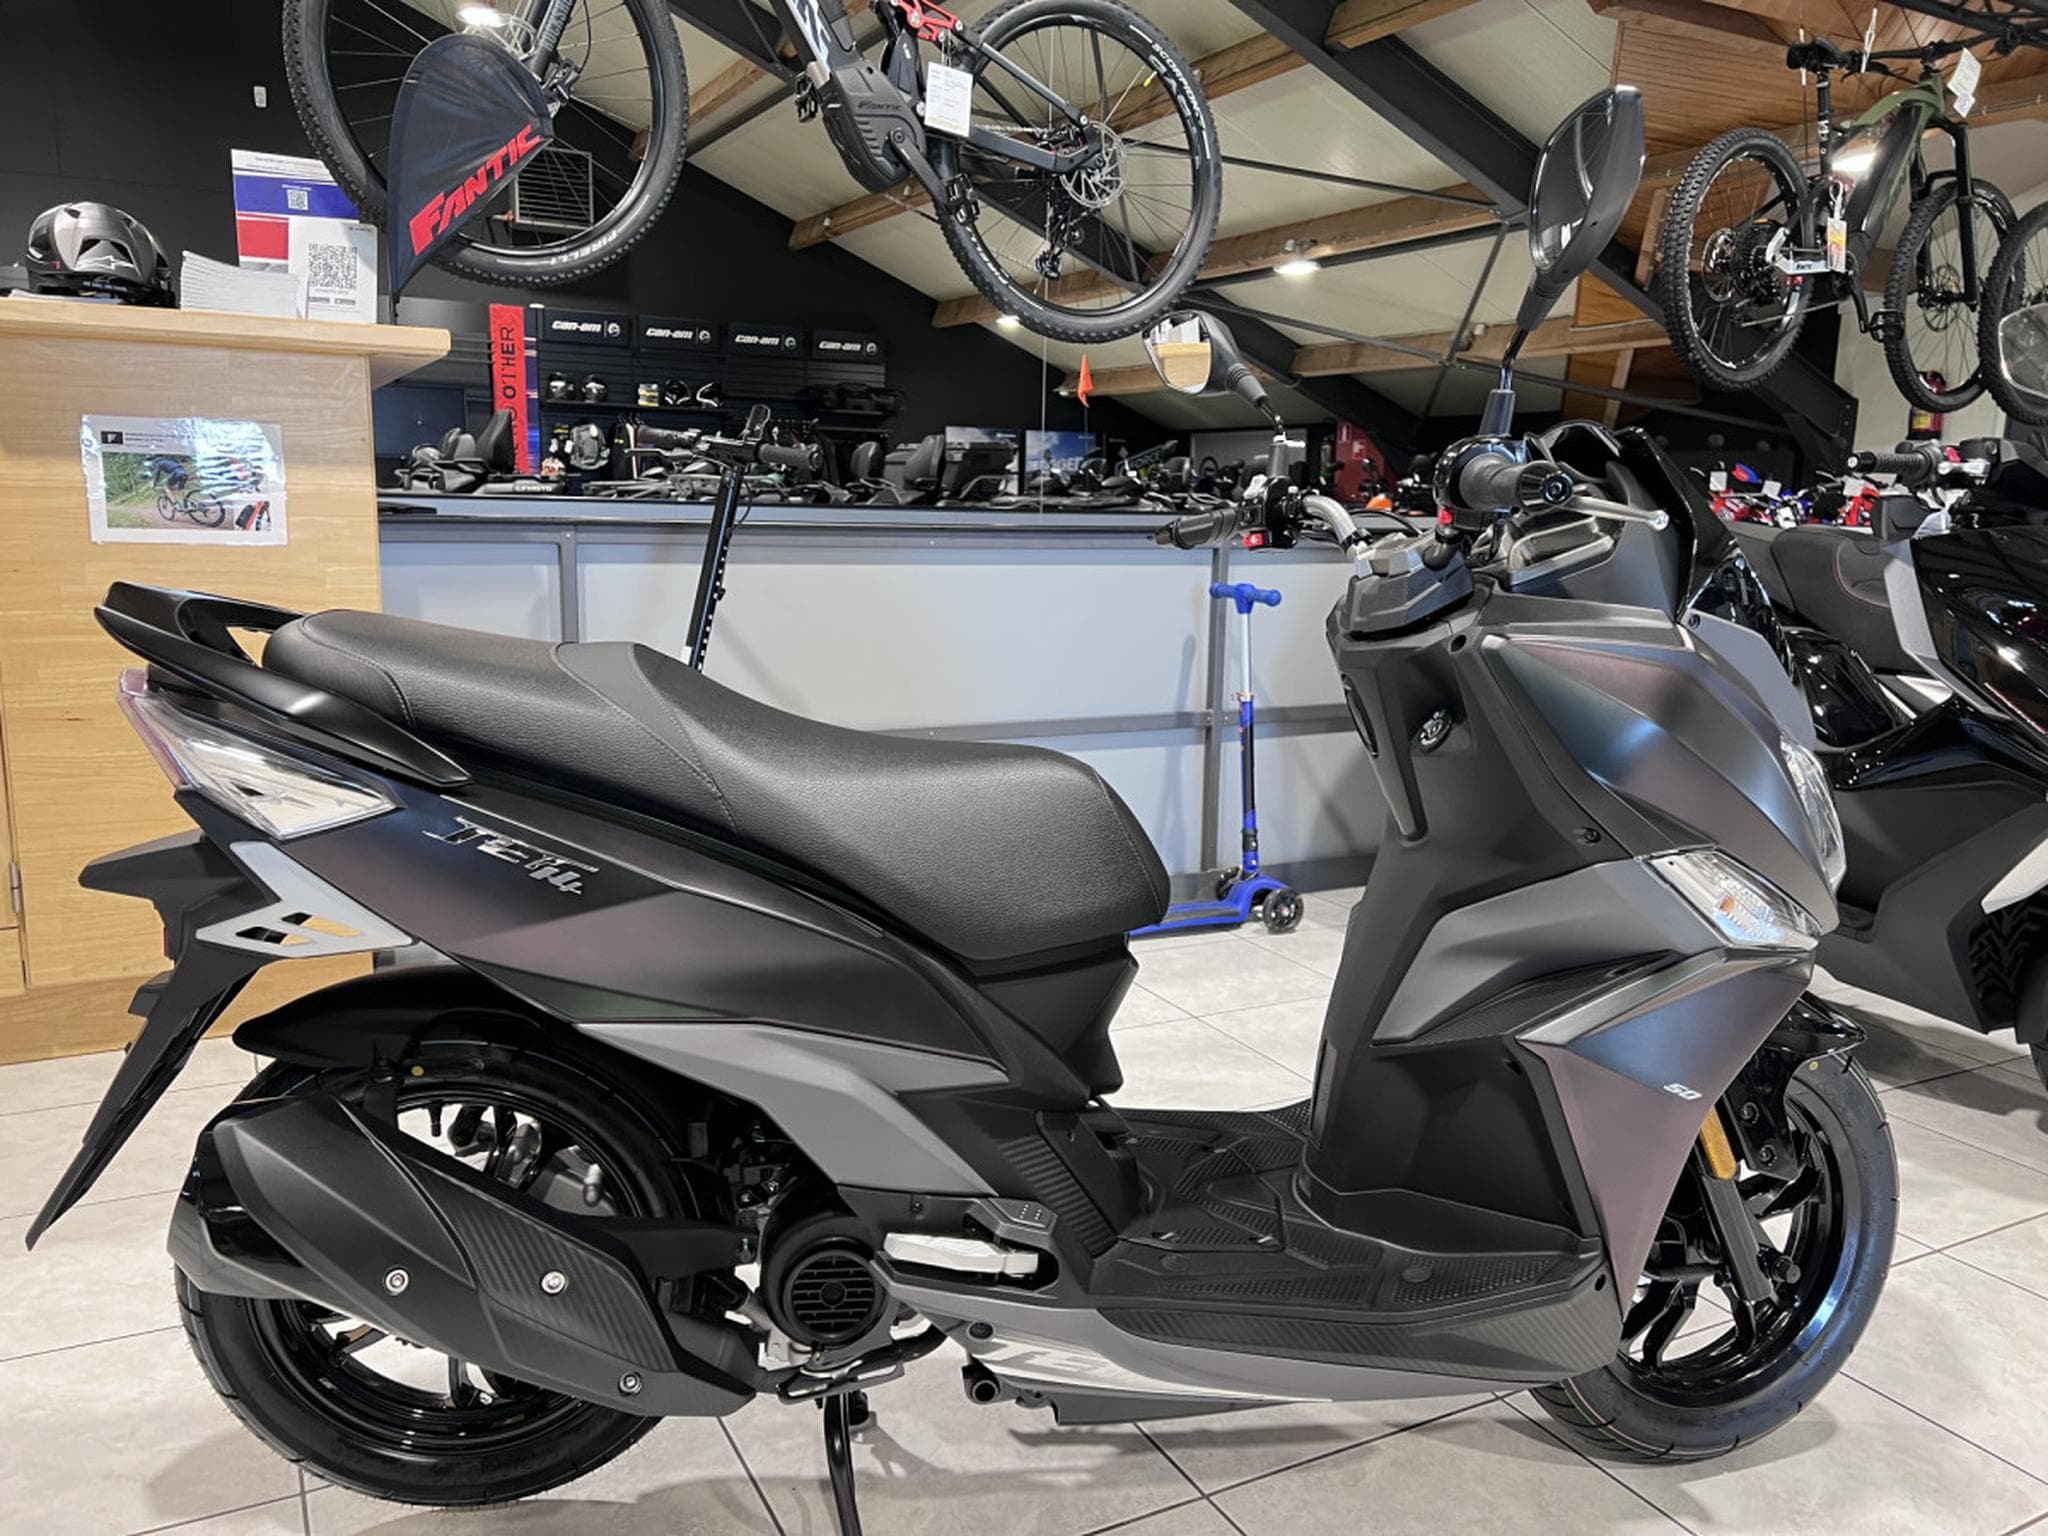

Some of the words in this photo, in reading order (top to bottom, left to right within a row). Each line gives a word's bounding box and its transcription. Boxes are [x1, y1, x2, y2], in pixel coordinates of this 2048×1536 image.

[409, 124, 541, 256] FANTIC
[552, 320, 601, 333] can-am
[646, 327, 693, 340] can-am
[735, 334, 780, 346] can-am
[818, 340, 861, 351] can-am
[500, 326, 517, 399] OTHER
[528, 866, 583, 895] 14
[1663, 1083, 1702, 1100] 50
